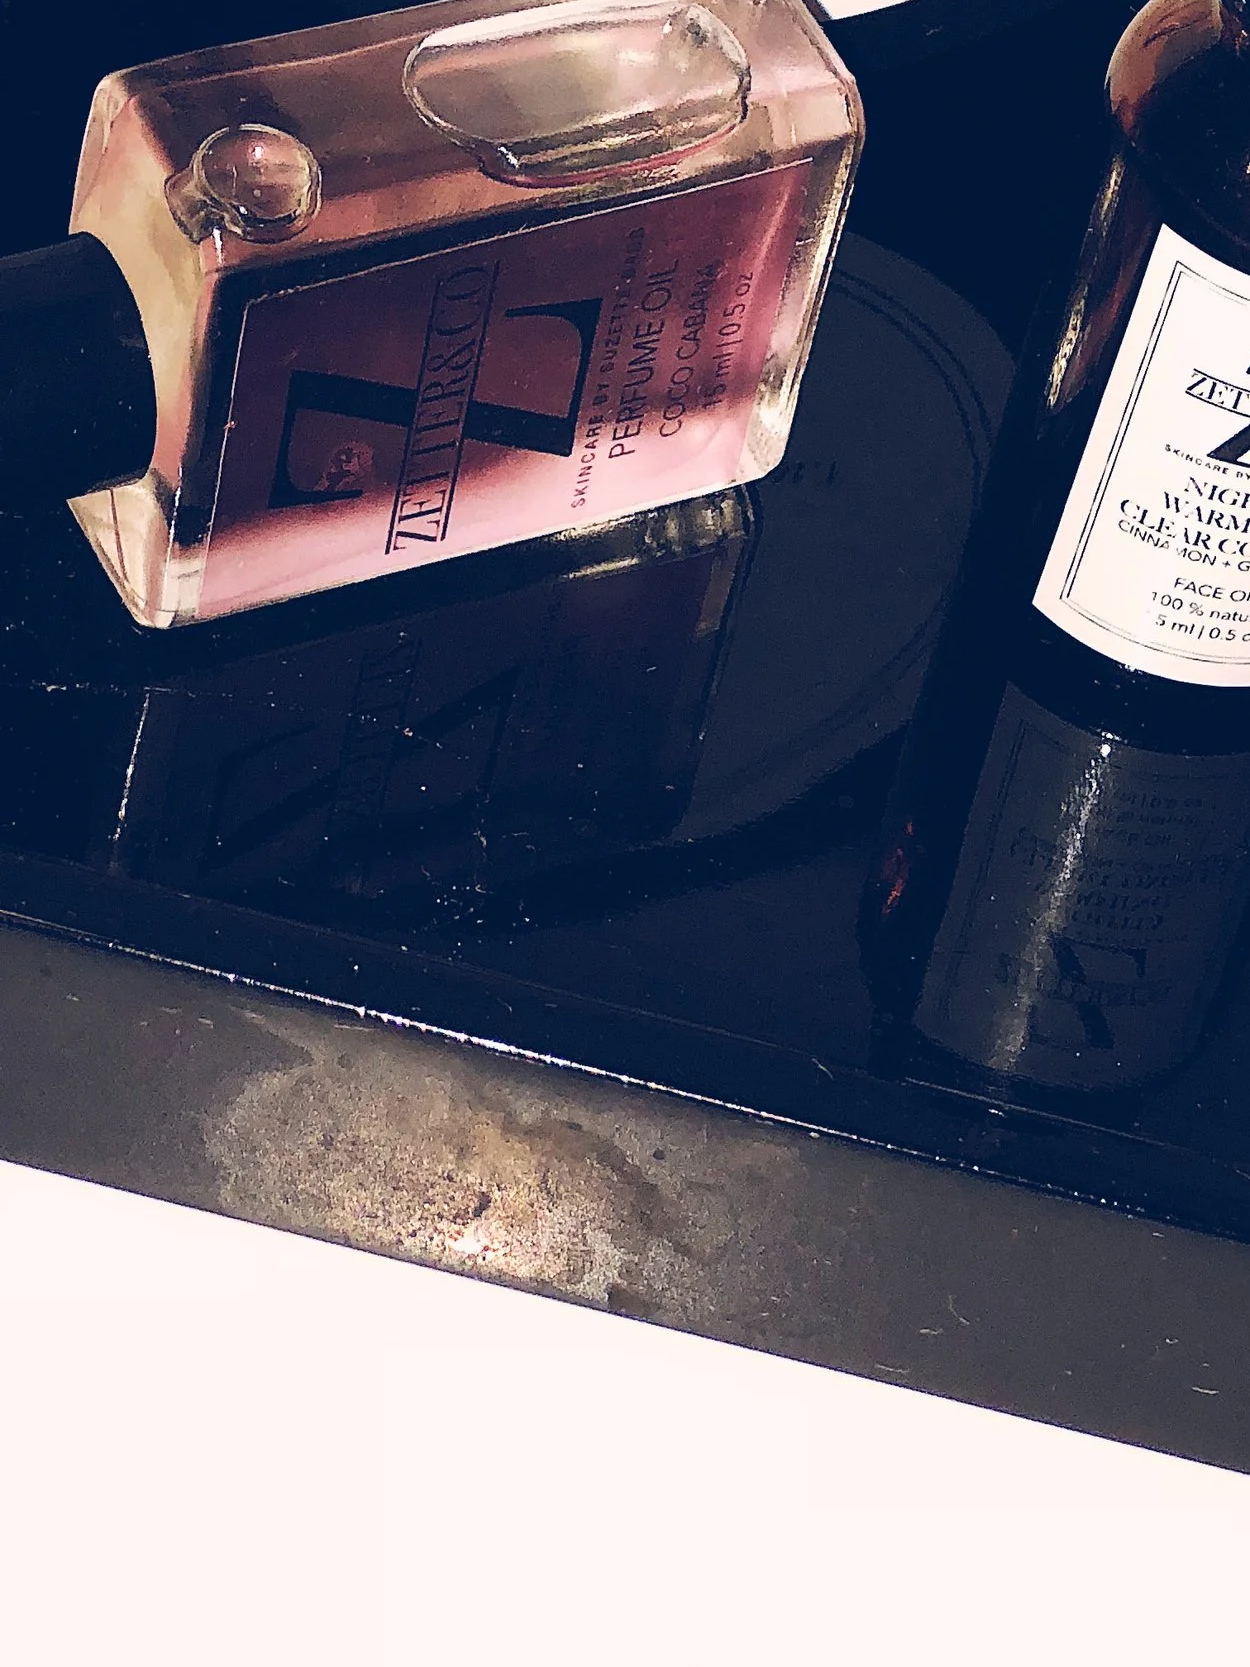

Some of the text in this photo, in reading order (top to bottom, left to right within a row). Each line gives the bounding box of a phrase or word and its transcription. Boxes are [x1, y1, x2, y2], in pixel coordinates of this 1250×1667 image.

[607, 259, 680, 459] PERFUME OIL
[392, 265, 489, 553] ZETTER&CO
[659, 366, 694, 437] COCO
[571, 413, 605, 509] SKINCARE
[1164, 444, 1229, 475] SKINCARE
[1236, 471, 1250, 480] BY
[1120, 499, 1212, 550] CLEAR
[1151, 591, 1183, 611] 100
[1189, 602, 1204, 616] %
[1174, 577, 1225, 600] FACE
[1171, 621, 1195, 635] ml
